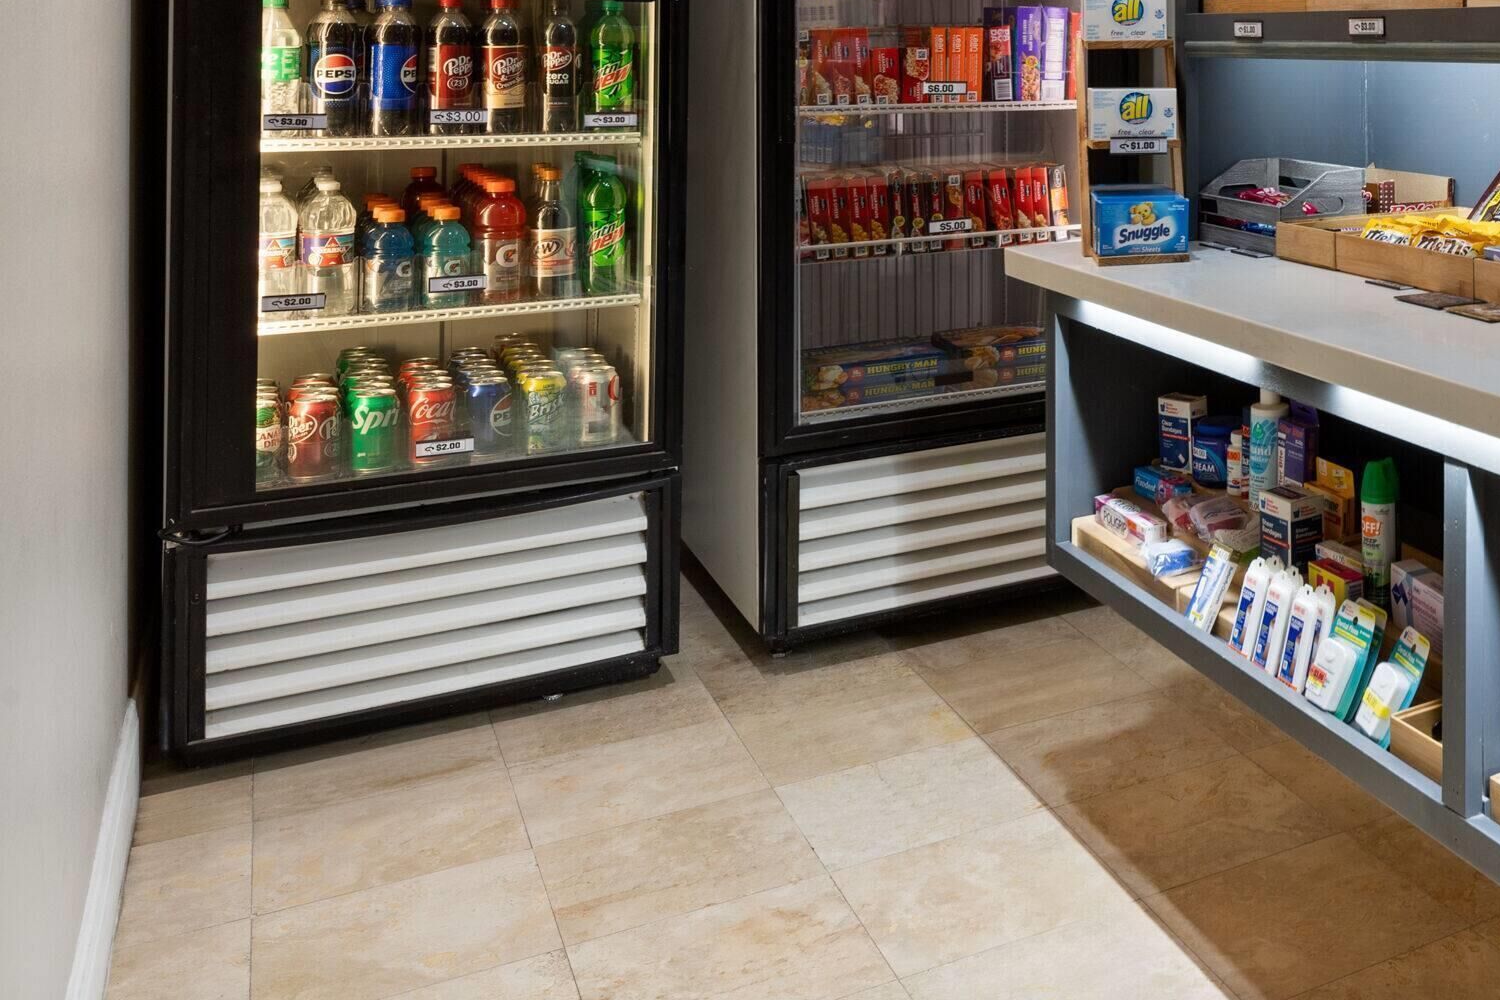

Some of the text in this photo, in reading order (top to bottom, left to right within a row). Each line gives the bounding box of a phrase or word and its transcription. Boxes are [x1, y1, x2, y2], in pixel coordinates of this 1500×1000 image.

[317, 70, 356, 78] PEPSI
[928, 84, 954, 93] $6.00
[1122, 95, 1149, 120] all
[446, 111, 480, 122] $3.00
[603, 116, 625, 124] $3.00
[280, 118, 307, 126] $3.00
[1130, 141, 1155, 150] $1.00
[940, 221, 966, 231] $5.00
[1118, 225, 1171, 245] Snuggle
[454, 279, 478, 288] $3.00
[284, 298, 311, 306] $2.00
[436, 443, 460, 451] $2.00
